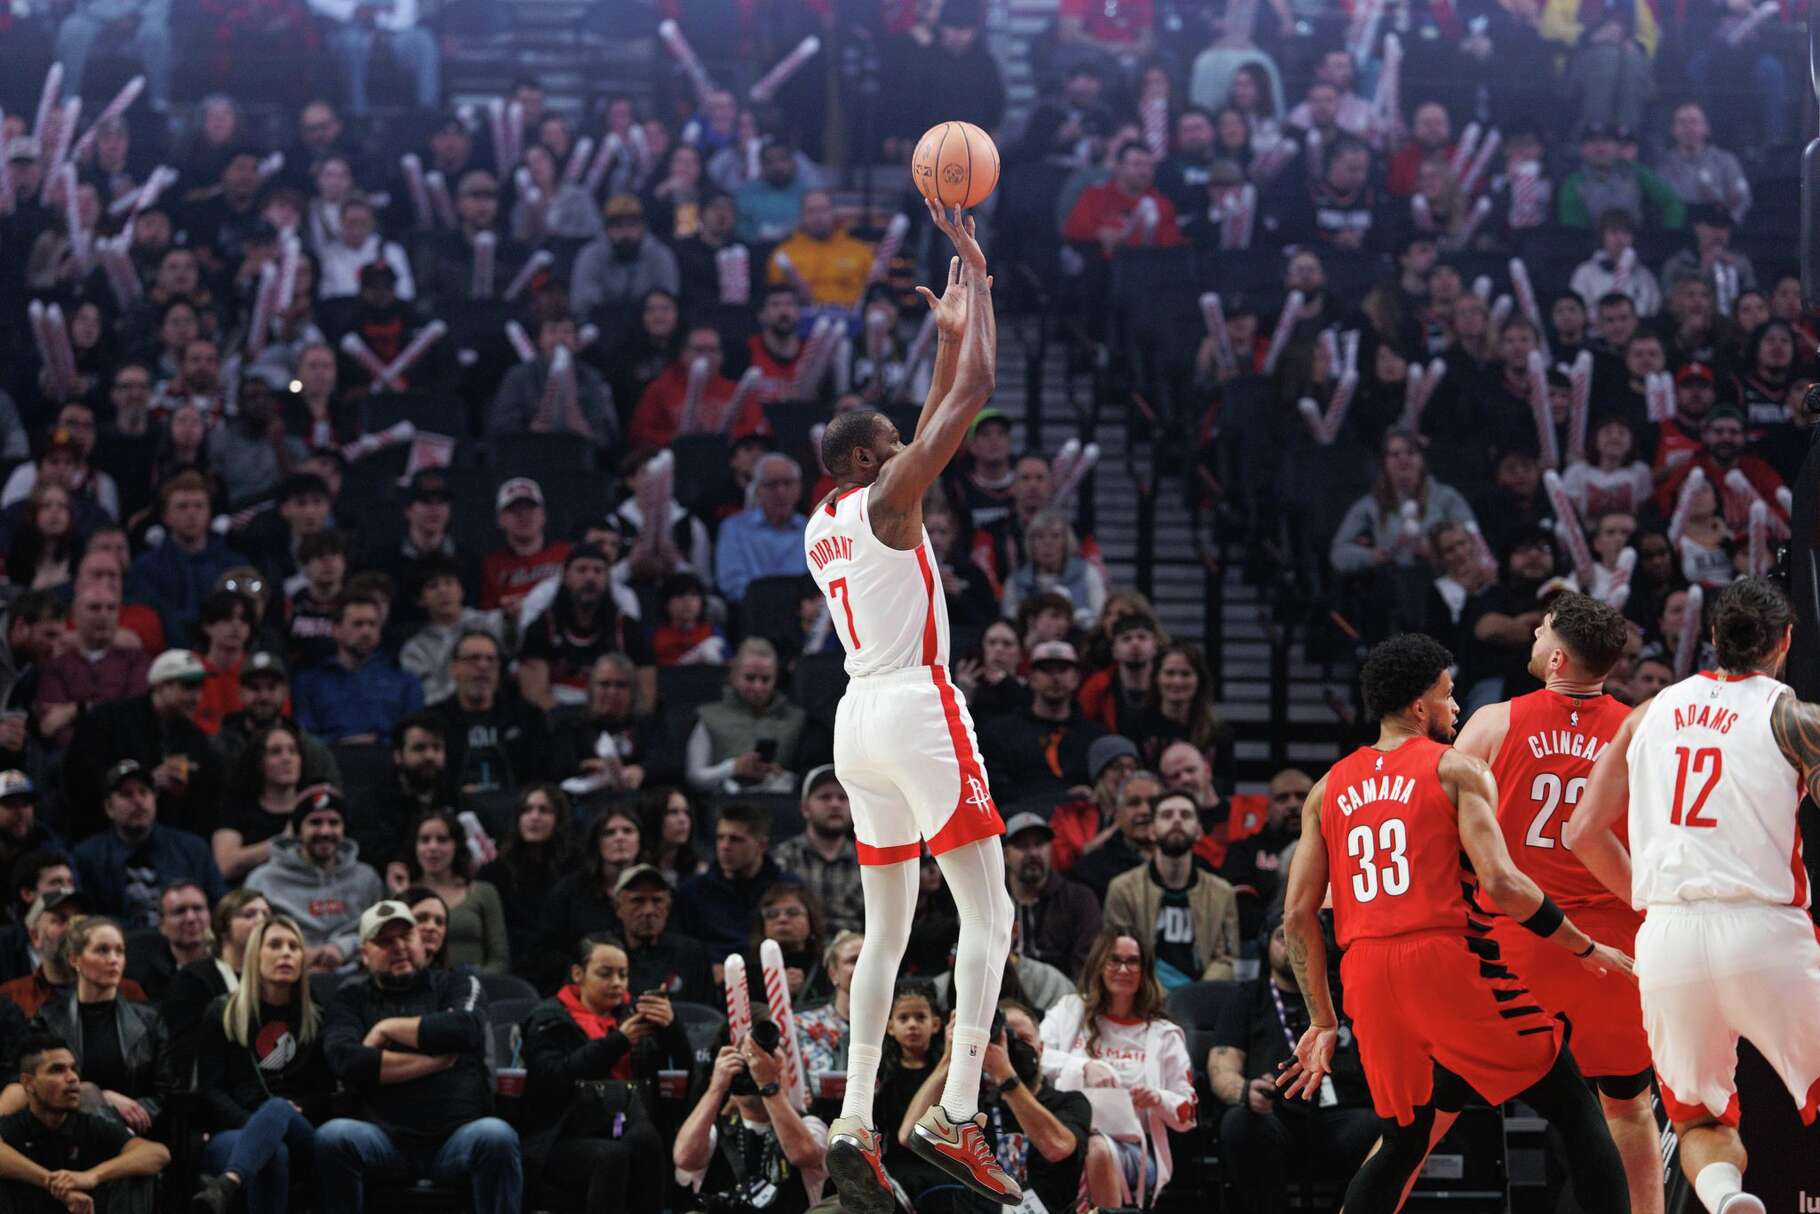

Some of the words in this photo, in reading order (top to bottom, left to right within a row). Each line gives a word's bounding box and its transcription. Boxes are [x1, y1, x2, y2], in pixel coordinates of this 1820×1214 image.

[809, 535, 854, 571] DURANT
[828, 577, 861, 650] 7
[1673, 703, 1739, 735] ADAMS
[1336, 774, 1417, 817] CAMARA
[1670, 746, 1723, 827] 12
[1347, 817, 1411, 903] 33
